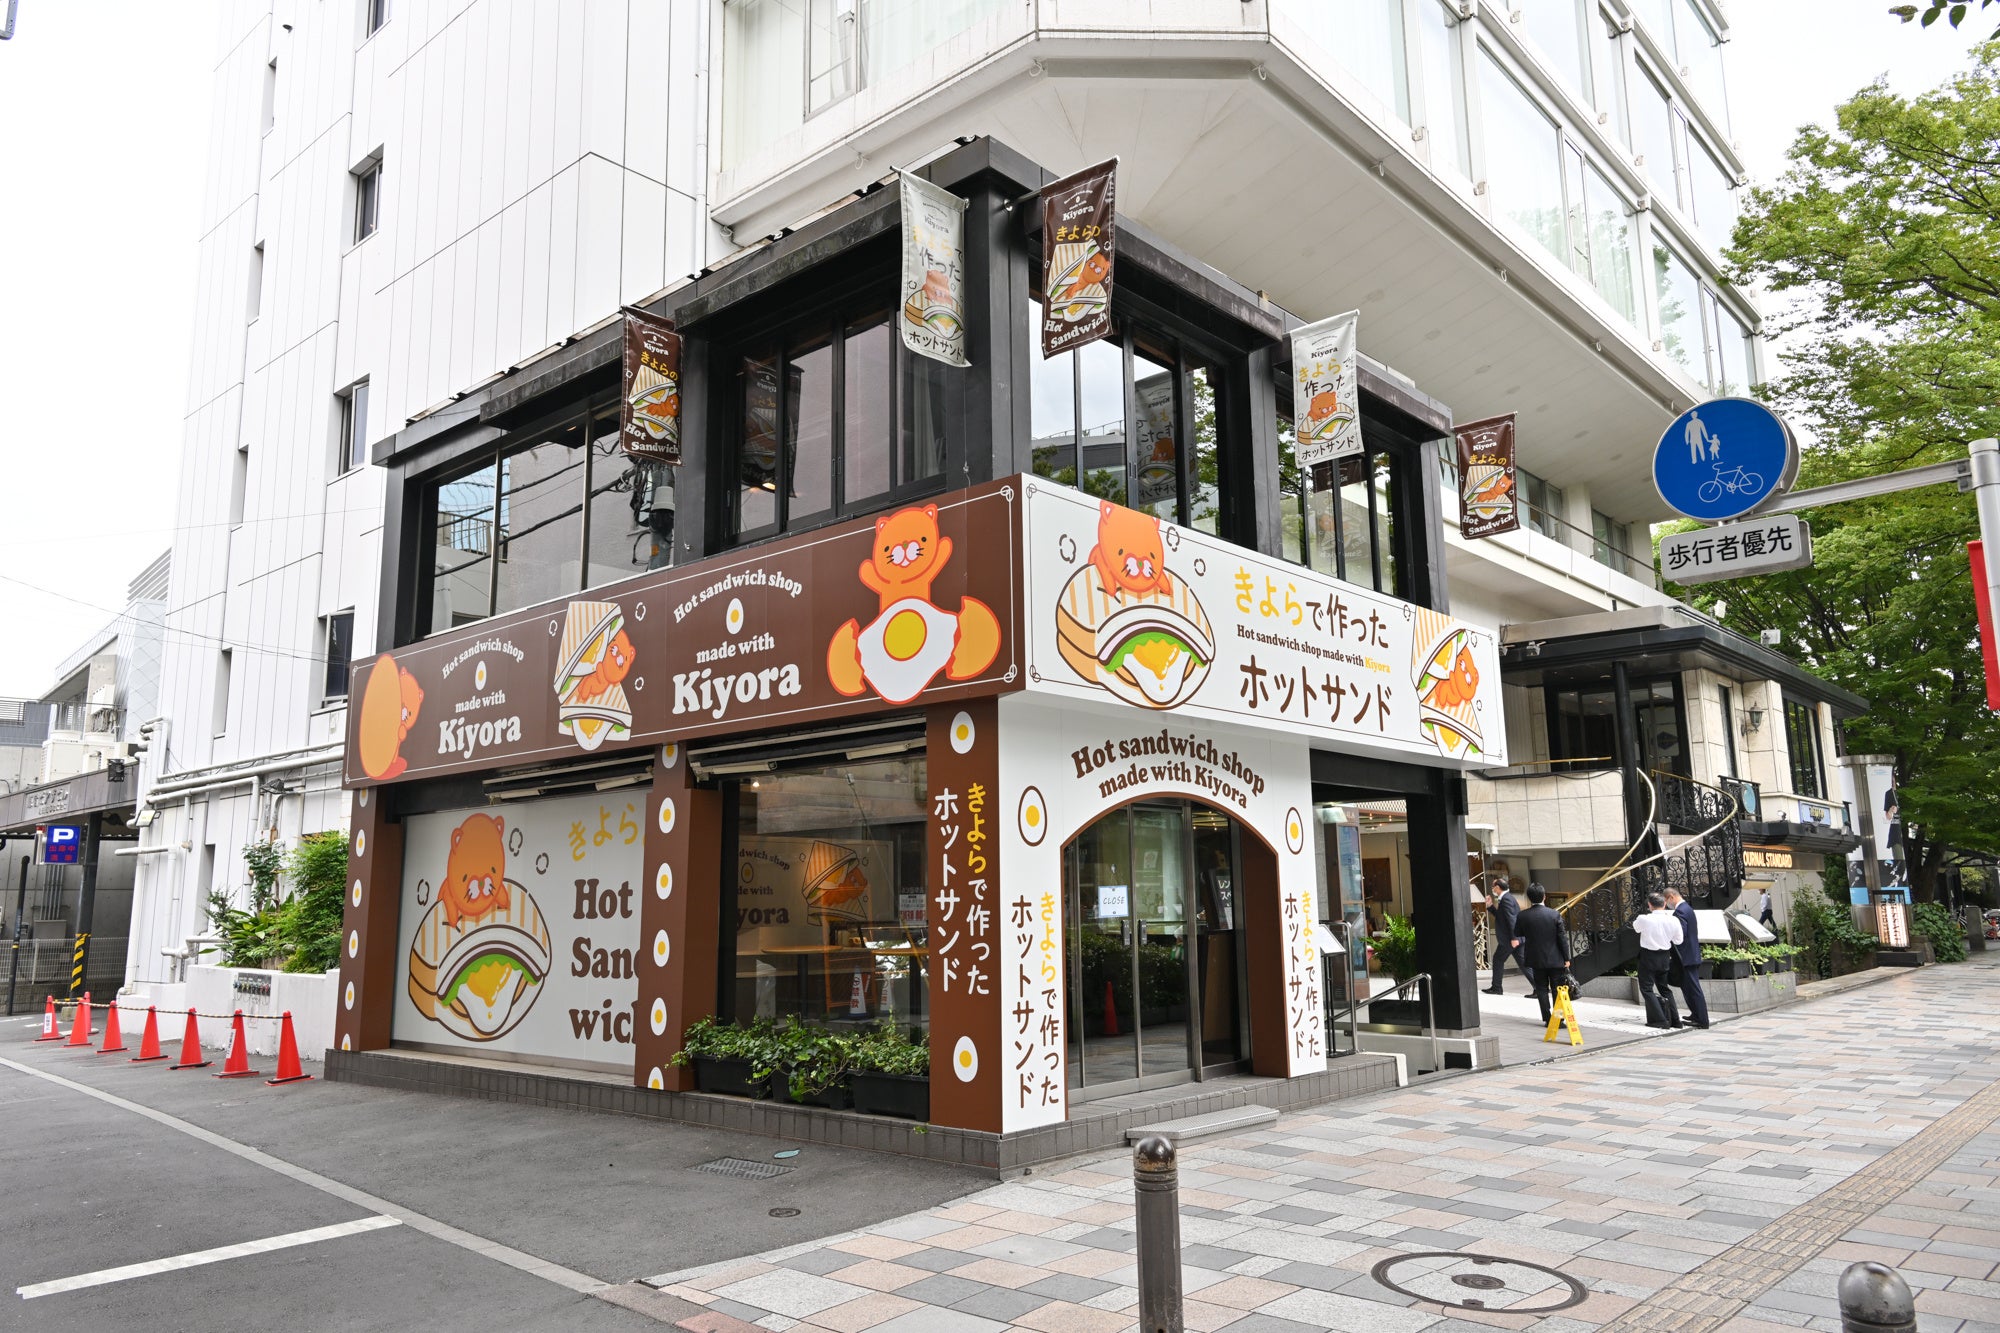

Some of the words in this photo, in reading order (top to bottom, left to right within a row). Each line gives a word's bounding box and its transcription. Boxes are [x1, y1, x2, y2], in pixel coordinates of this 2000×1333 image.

[1062, 205, 1094, 221] Kiyora
[1056, 224, 1101, 241] きよらの
[908, 331, 963, 360] ホットサンド
[1050, 311, 1107, 349] Sandwich
[640, 351, 678, 381] きよらの
[1311, 347, 1338, 359] Kiyora
[625, 422, 647, 441] Hot
[631, 441, 679, 454] Sandwich
[1301, 435, 1355, 461] ホットサンド
[1469, 453, 1507, 466] きよらの
[1462, 514, 1479, 525] Hot
[1468, 514, 1514, 535] Sandwich
[1668, 525, 1793, 571] 歩行者優先
[673, 594, 698, 623] Hot
[699, 569, 766, 602] sandwich
[768, 571, 802, 598] shop
[1234, 565, 1389, 649] きよらで作った
[441, 659, 459, 679] Hot
[458, 638, 502, 663] sandwich
[502, 640, 525, 663] shop
[696, 641, 736, 664] made
[738, 632, 775, 655] with
[1236, 624, 1255, 640] Hot
[1256, 631, 1300, 652] sandwich
[1301, 641, 1322, 659] shop
[1322, 648, 1345, 662] made
[1345, 653, 1364, 668] with
[1364, 656, 1391, 674] Kiyora
[455, 695, 481, 713] made
[482, 689, 506, 707] with
[672, 663, 802, 720] Kiyora
[1239, 654, 1392, 732] ホットサンド
[437, 715, 522, 760] Kiyora
[1071, 739, 1117, 779] Hot
[1119, 728, 1219, 766] sandwich
[1221, 751, 1265, 798] shop
[1098, 763, 1149, 799] made
[1150, 760, 1192, 783] with
[1194, 764, 1248, 809] Kiyora
[52, 828, 74, 843] P
[568, 802, 645, 862] きよら
[739, 847, 768, 860] dwich
[768, 855, 791, 871] shop
[1743, 850, 1767, 867] OURNAL
[1765, 852, 1793, 869] STANDARD
[572, 878, 633, 920] Hot
[750, 885, 774, 896] with
[934, 787, 960, 992] ホットサンド
[966, 782, 991, 995] きよらで作った
[1103, 896, 1125, 905] CLOSE
[737, 907, 790, 929] yora
[1284, 892, 1304, 1059] ホットサンド
[1301, 890, 1320, 1057] きよらで作った
[1011, 894, 1035, 1109] ホットサンド
[1039, 891, 1060, 1107] きよらで作った
